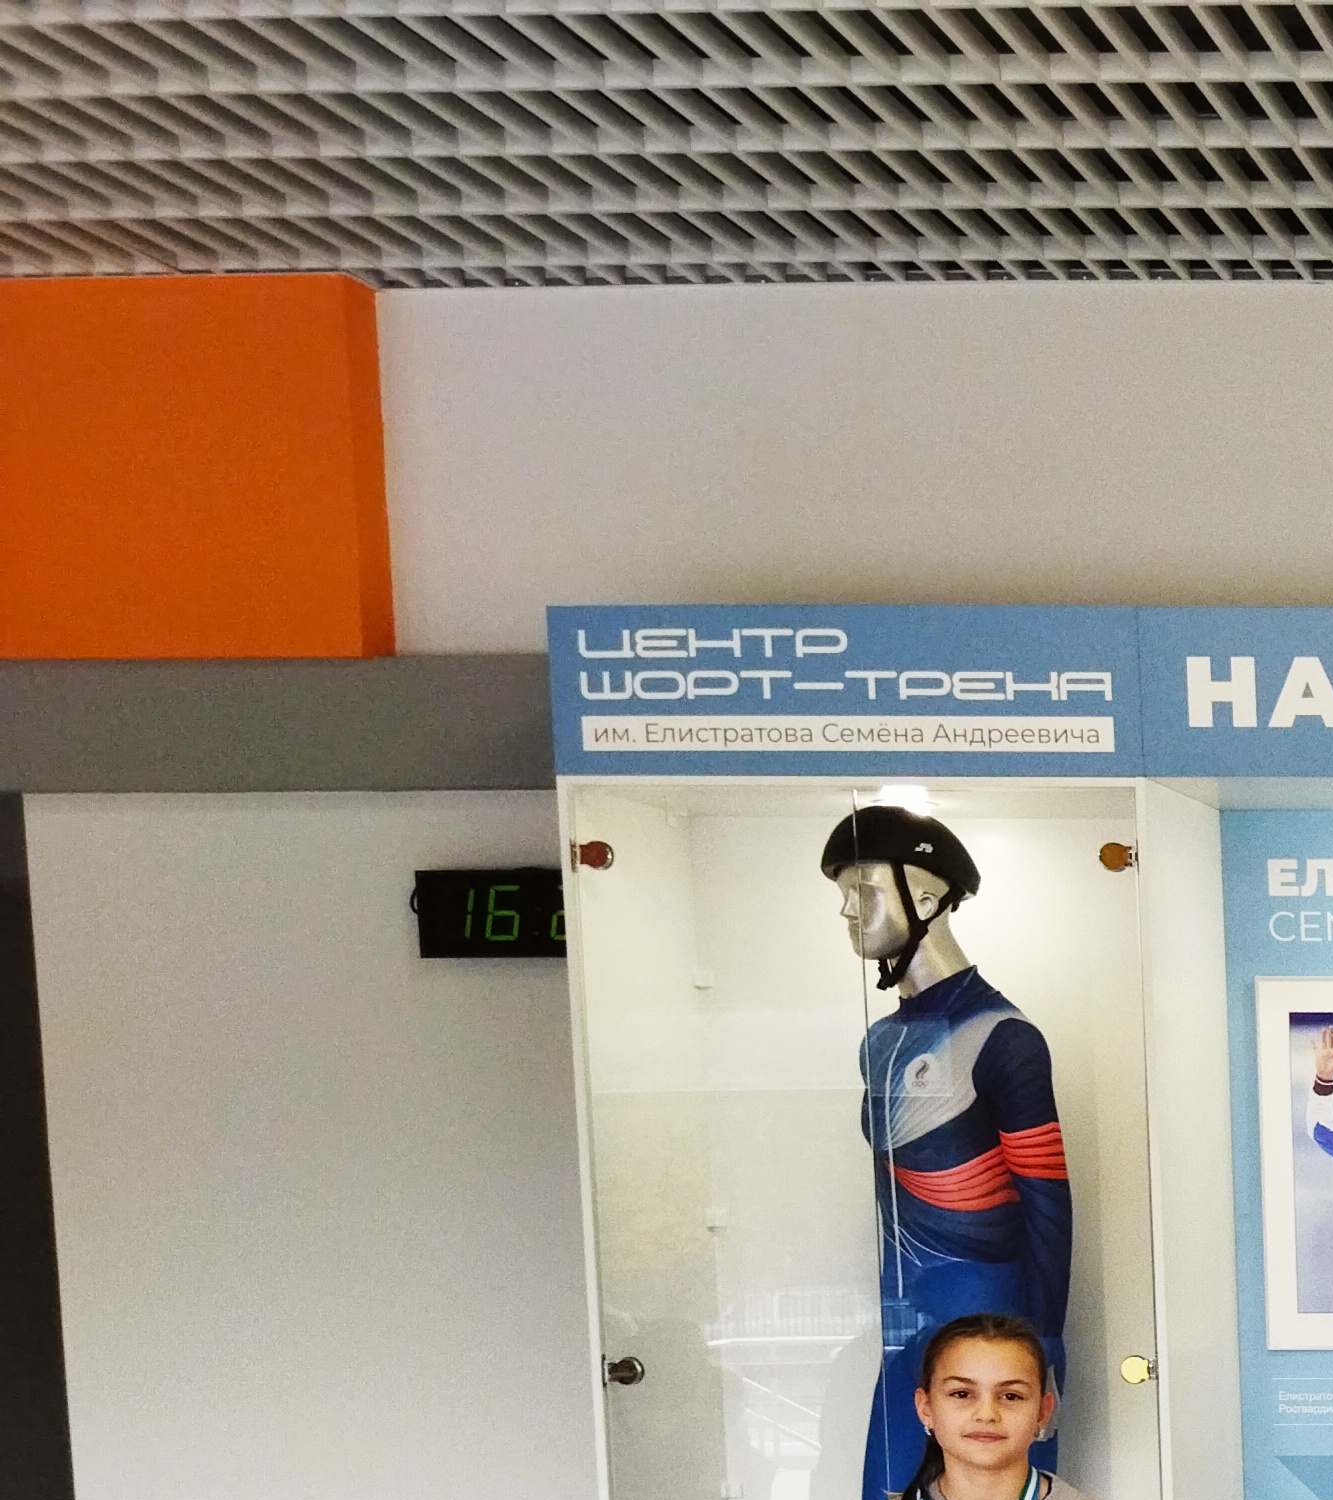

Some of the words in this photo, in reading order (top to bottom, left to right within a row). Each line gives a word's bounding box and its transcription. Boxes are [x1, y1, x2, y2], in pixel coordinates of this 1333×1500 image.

[578, 628, 847, 658] ЦЕНТР
[581, 671, 1112, 701] ШОРТ-ТРЕКА
[595, 728, 635, 742] им.
[645, 723, 812, 747] Елистратова
[822, 723, 923, 743] Семёна
[933, 724, 1099, 748] Андреевича
[464, 885, 520, 941] 16
